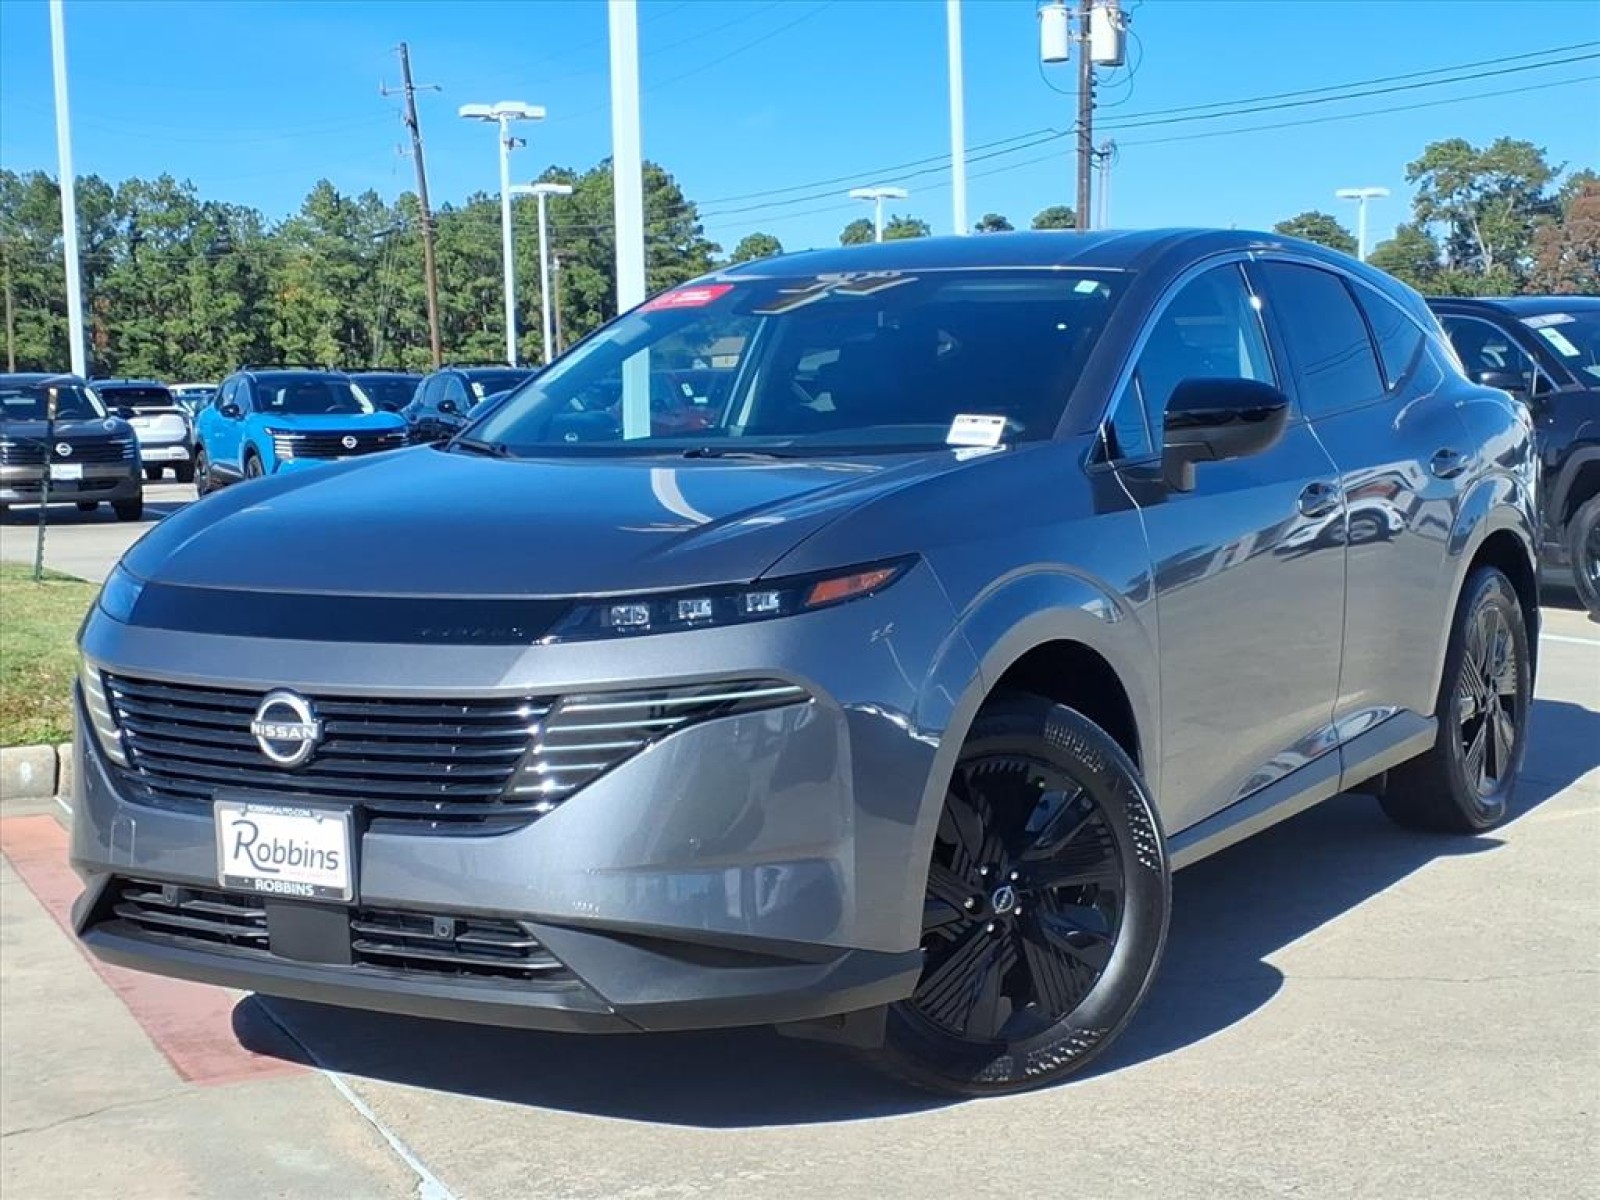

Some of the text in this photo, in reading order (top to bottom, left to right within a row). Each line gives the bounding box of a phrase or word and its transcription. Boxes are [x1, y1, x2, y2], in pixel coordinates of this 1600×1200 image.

[251, 722, 317, 739] NISSAN
[231, 819, 340, 873] Robbins
[254, 879, 315, 897] ROBBINS
